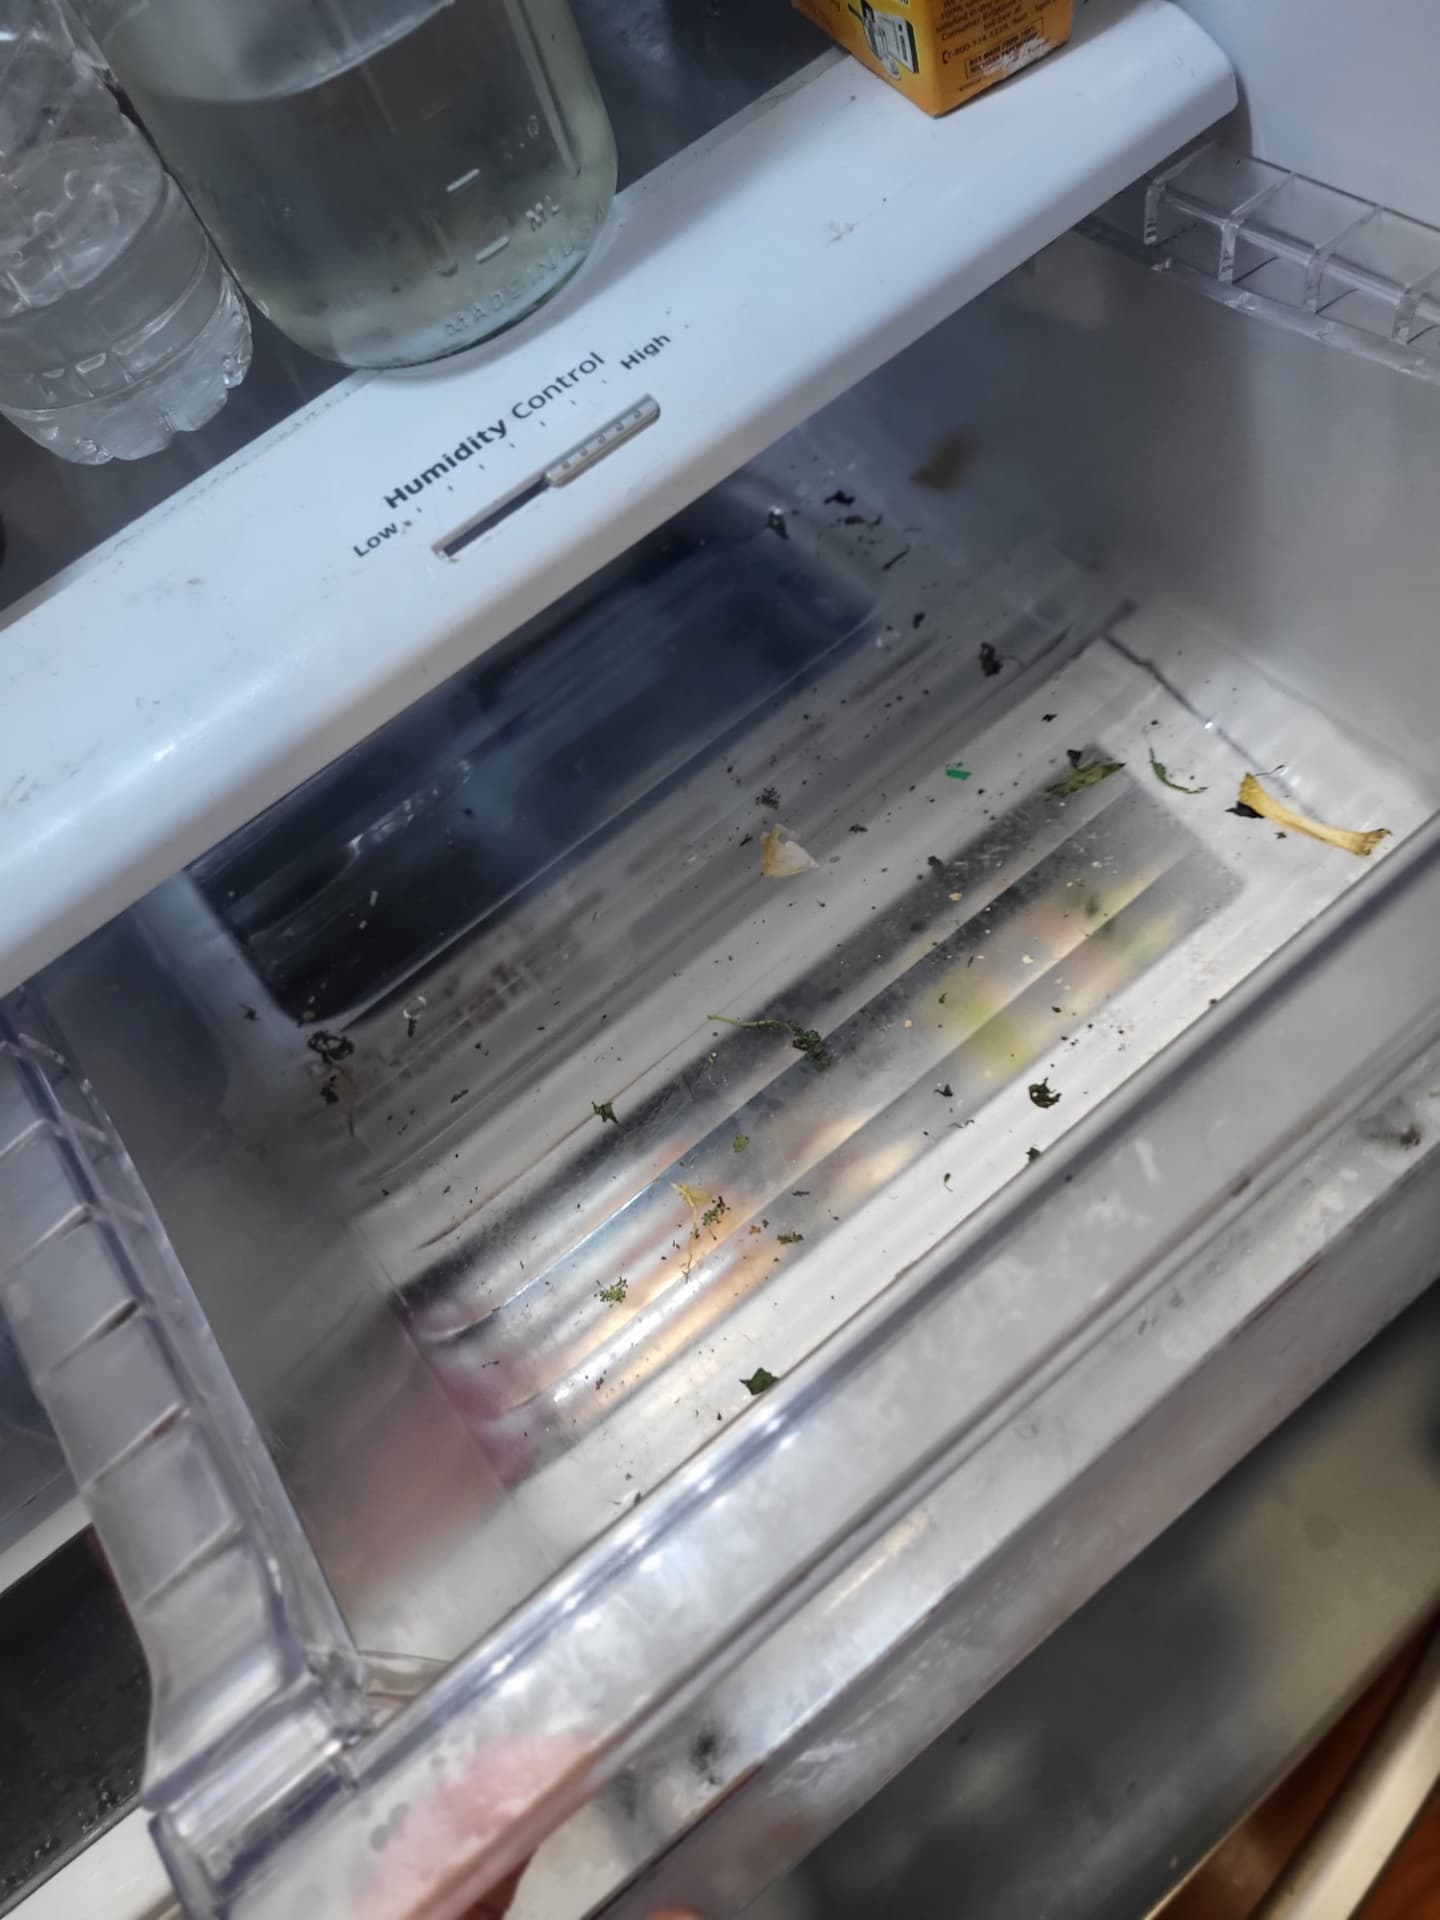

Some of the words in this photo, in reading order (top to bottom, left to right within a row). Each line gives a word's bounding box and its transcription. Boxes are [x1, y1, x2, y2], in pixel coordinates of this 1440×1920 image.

[619, 333, 671, 370] High
[383, 418, 508, 510] Humidity
[511, 351, 606, 420] Control
[353, 523, 399, 557] Low
